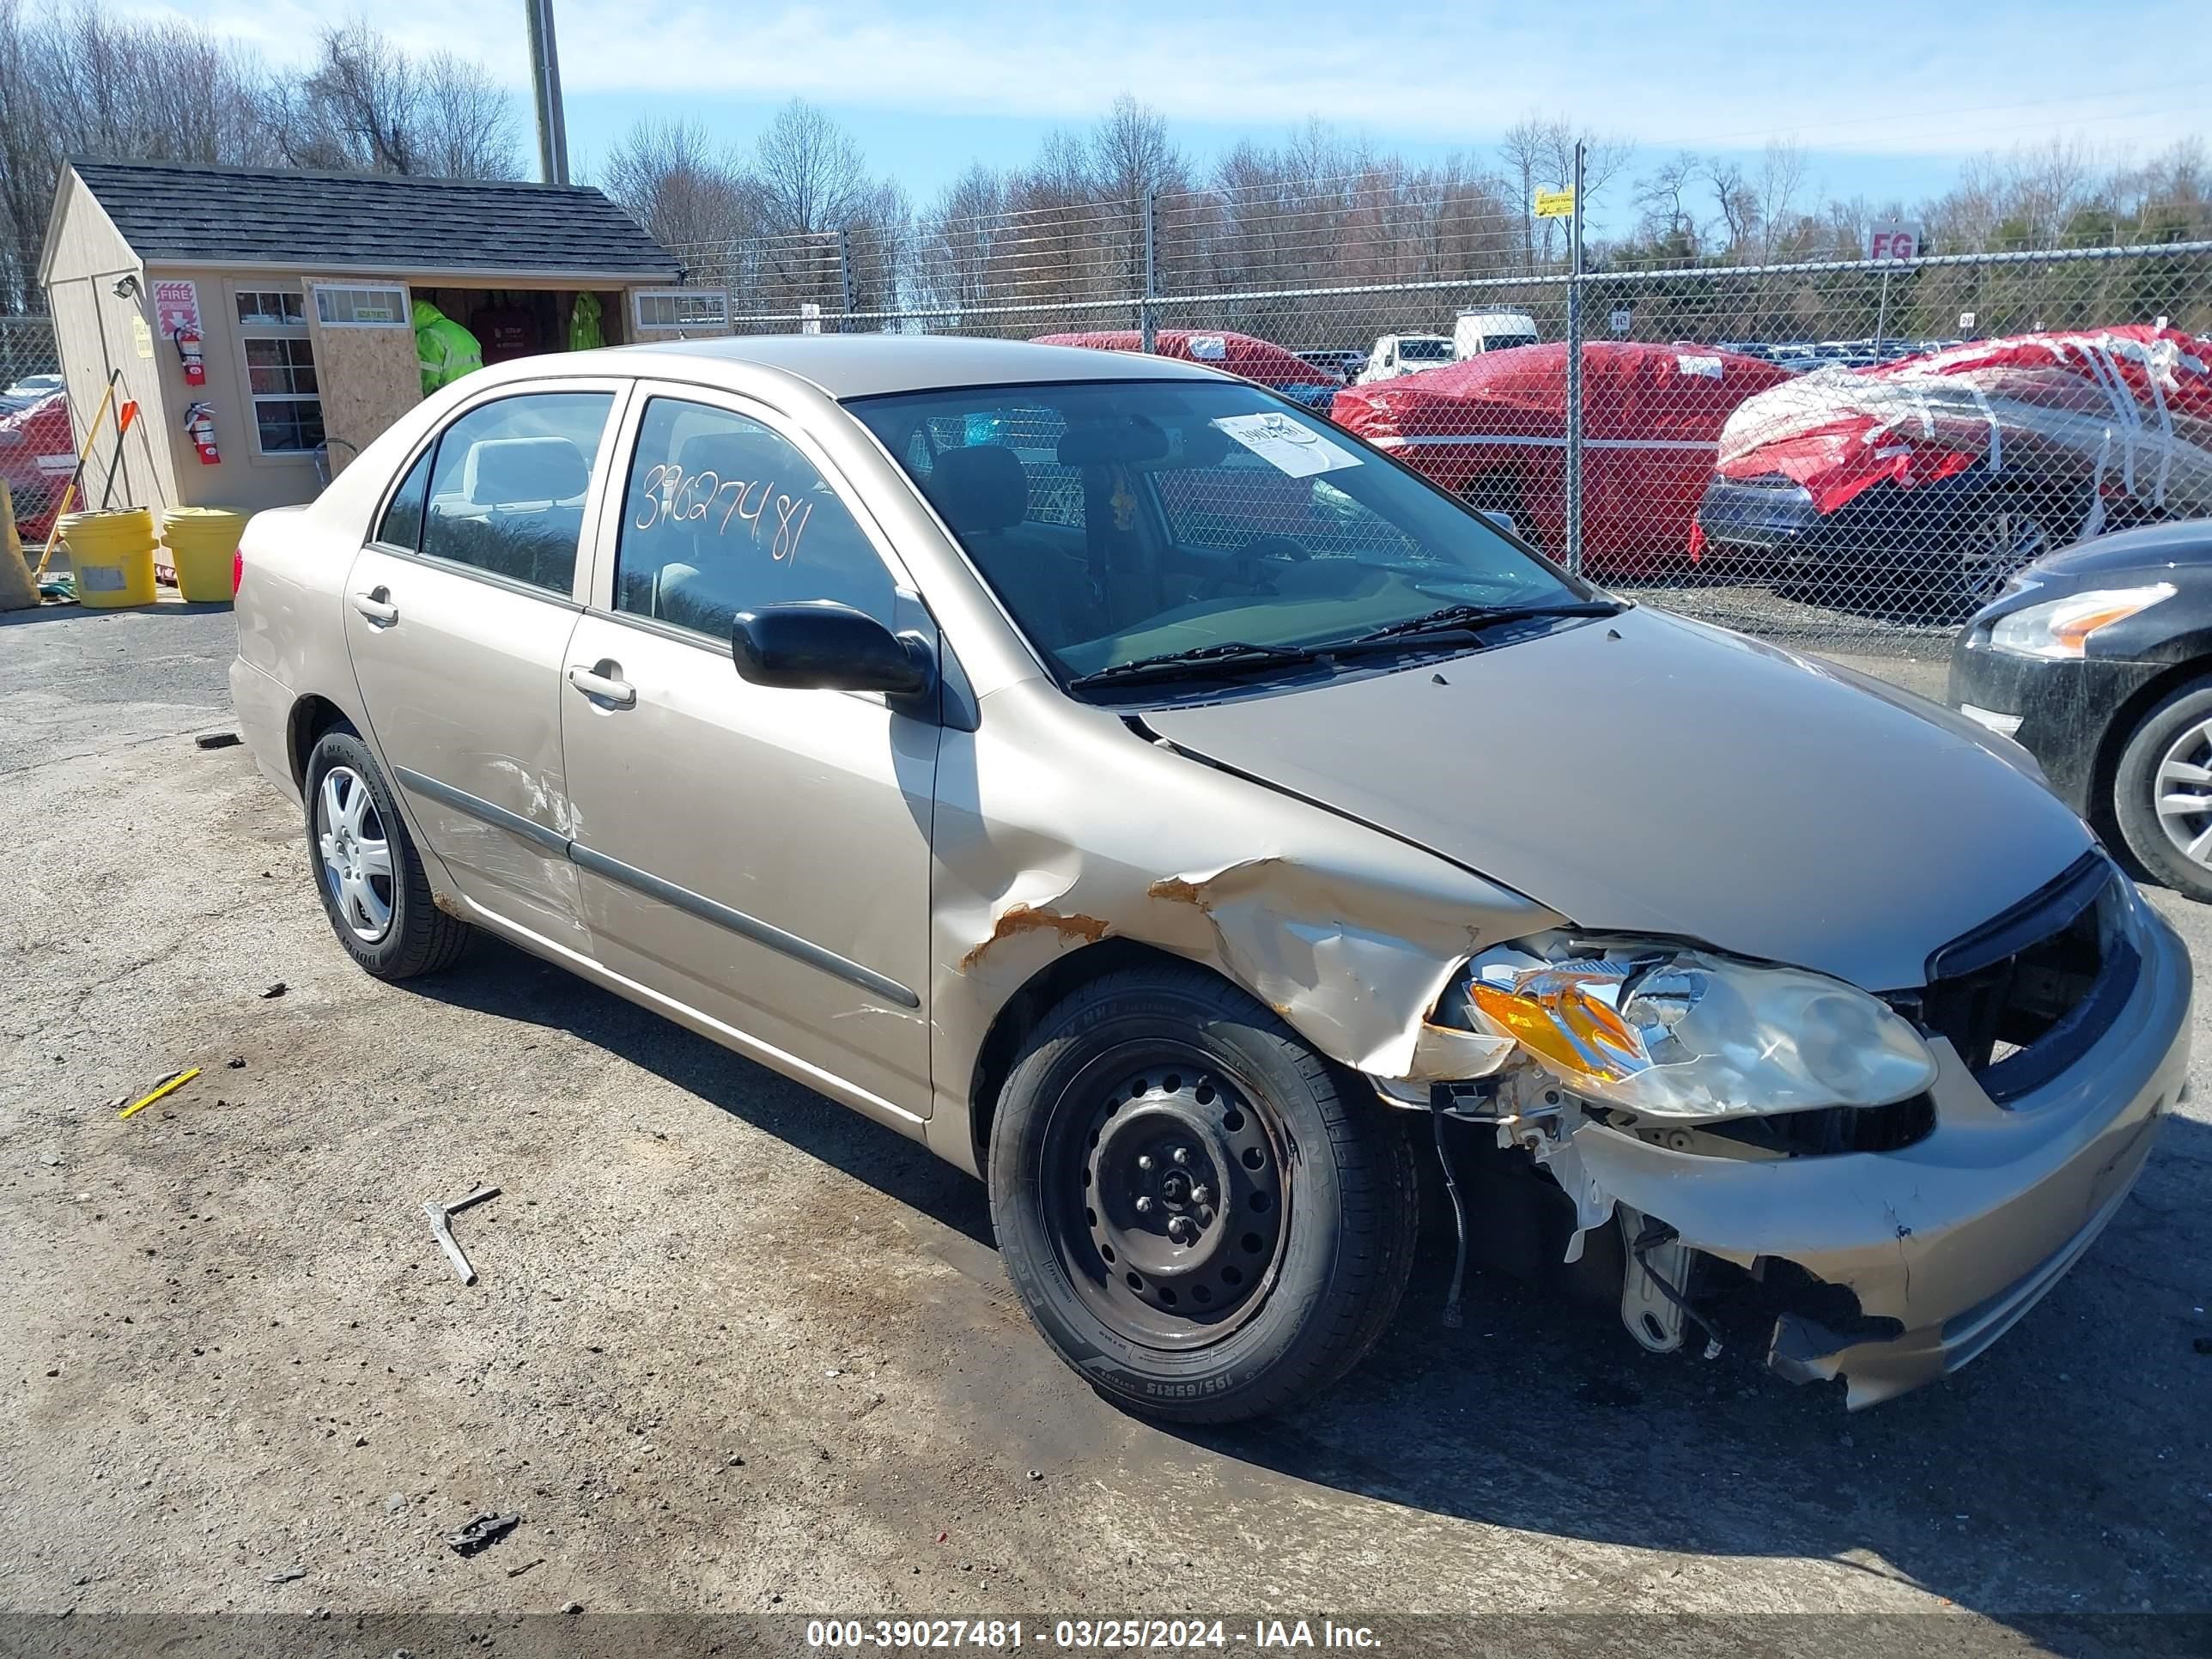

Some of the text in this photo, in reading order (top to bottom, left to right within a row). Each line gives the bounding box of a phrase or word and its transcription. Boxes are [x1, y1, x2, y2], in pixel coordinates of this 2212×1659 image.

[1872, 233, 1913, 260] FG
[160, 289, 190, 301] FIRE
[1961, 316, 1973, 325] 20
[636, 465, 813, 568] 39027481
[1146, 1372, 1234, 1397] 195/65R15
